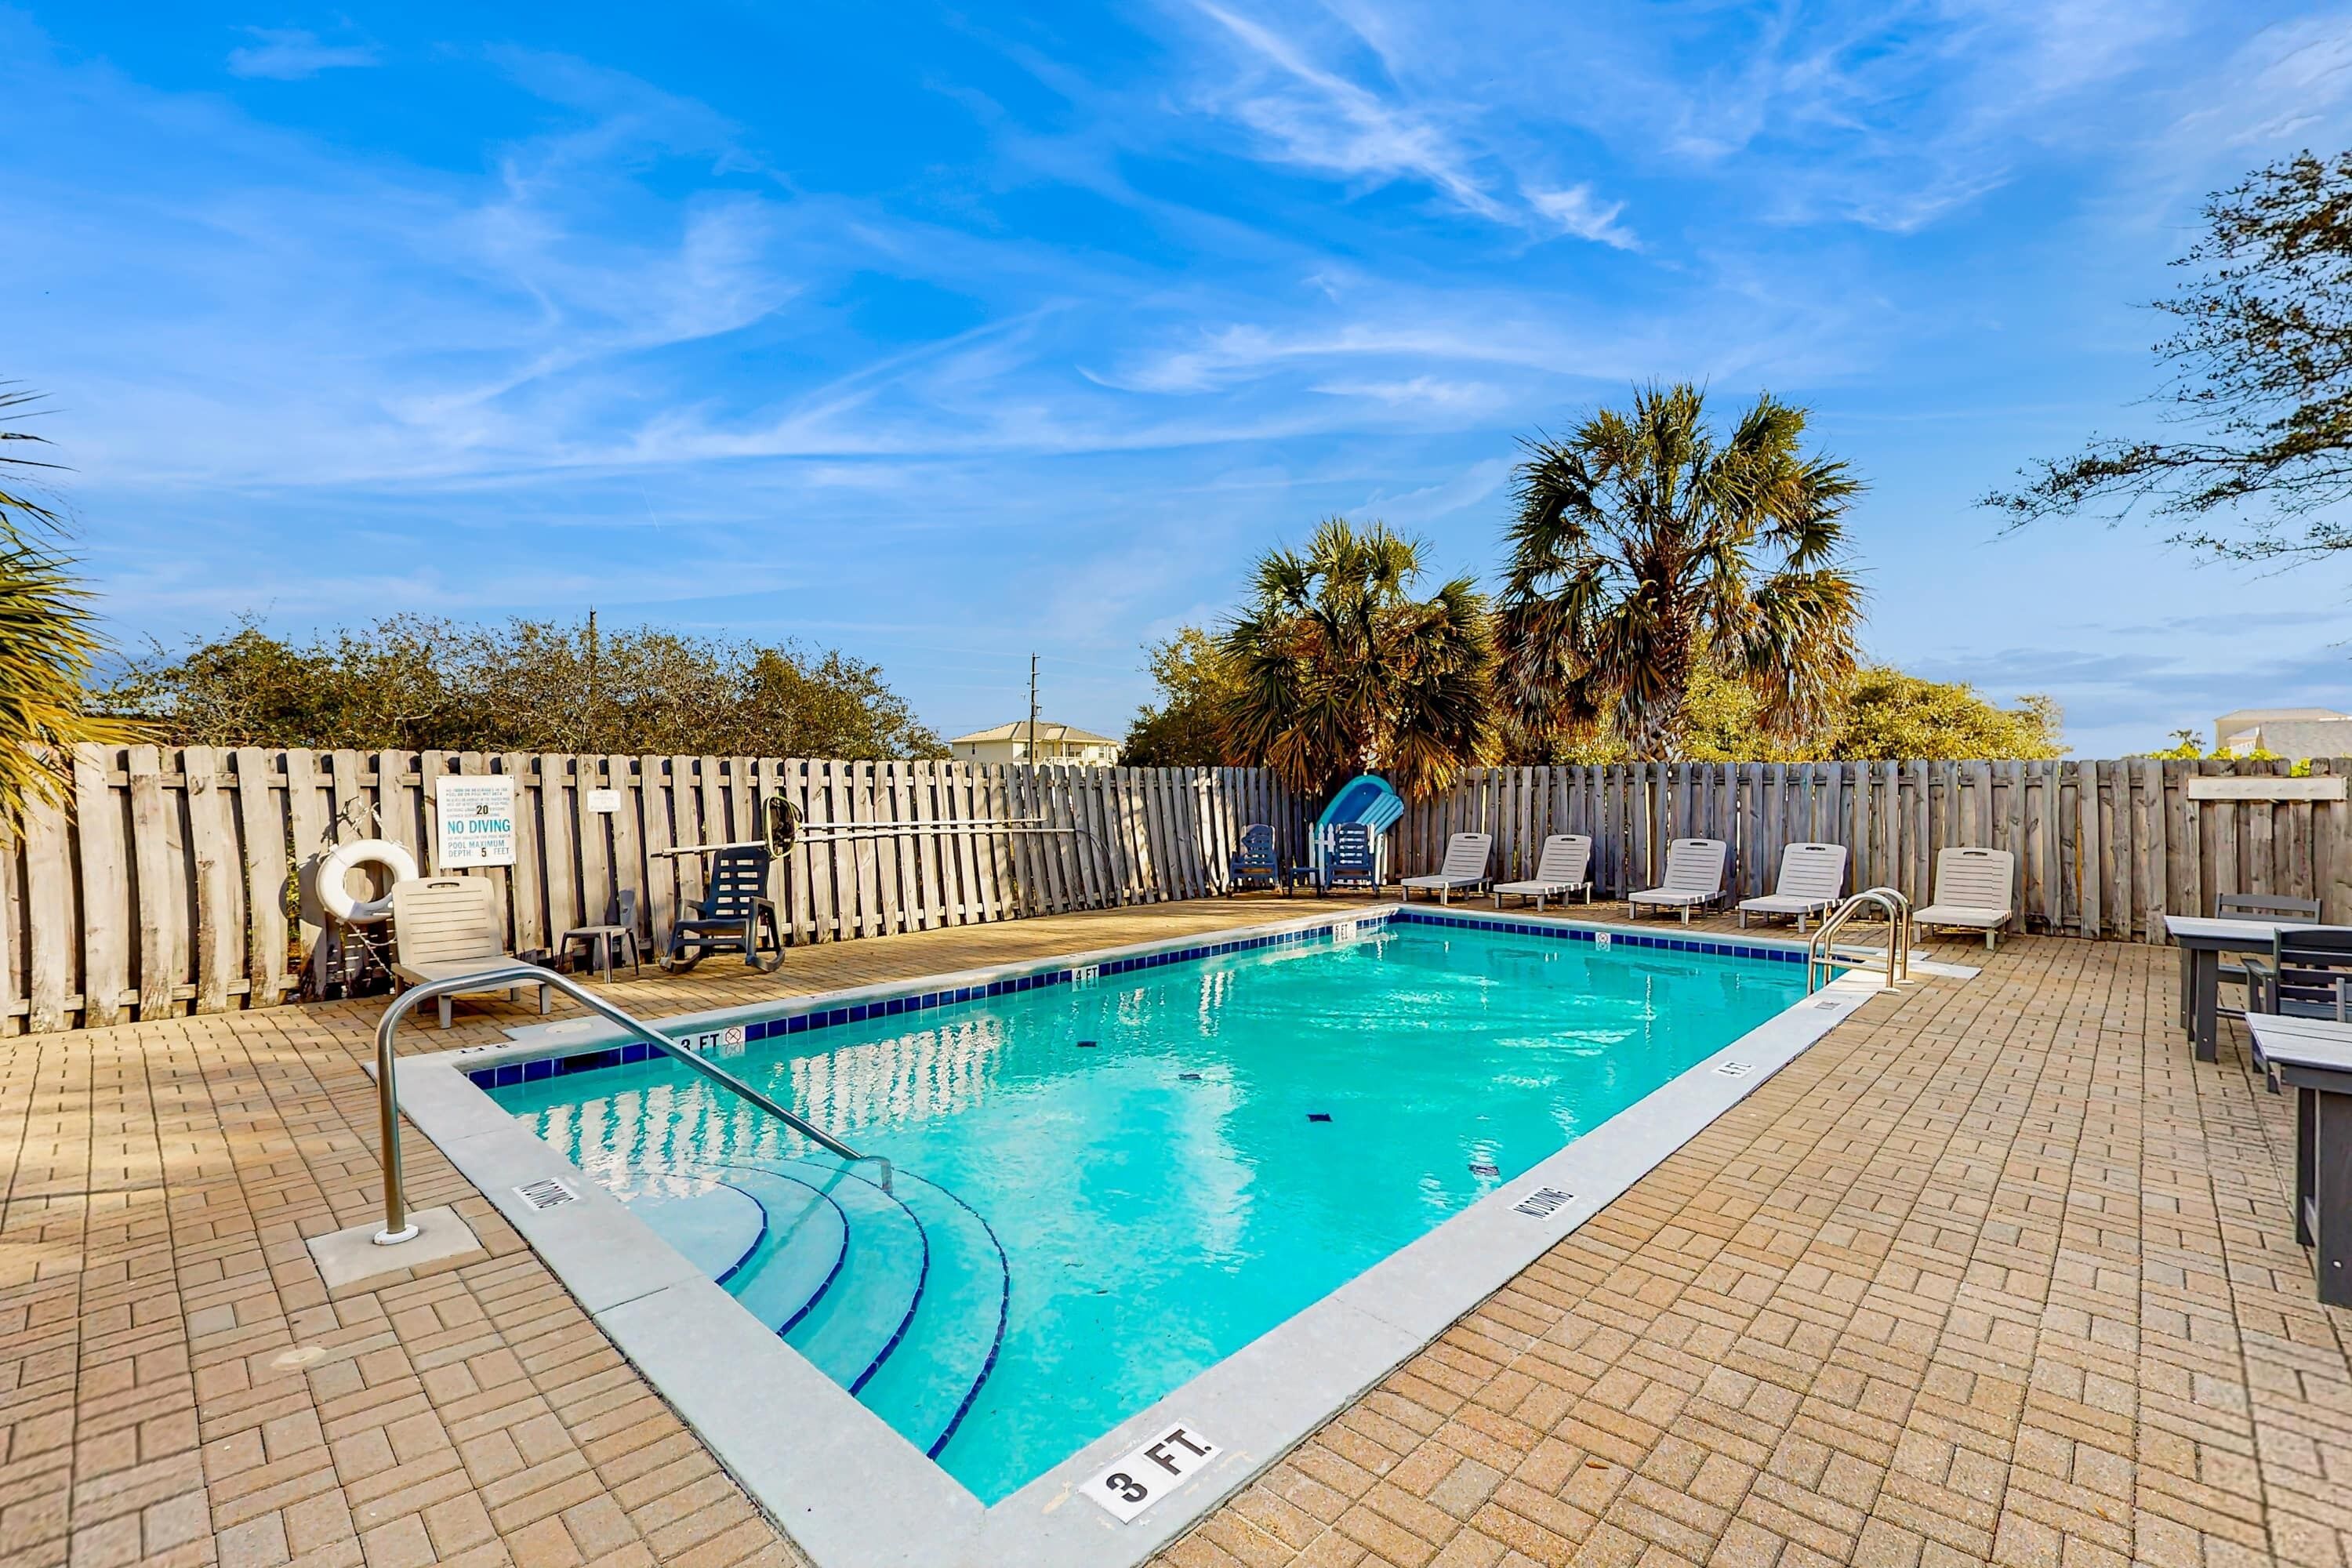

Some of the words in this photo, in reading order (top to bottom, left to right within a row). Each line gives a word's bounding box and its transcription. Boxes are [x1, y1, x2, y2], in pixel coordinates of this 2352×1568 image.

[477, 804, 488, 815] 20
[448, 820, 464, 834] NO
[470, 818, 510, 833] DIVING
[481, 848, 487, 857] 5
[1076, 970, 1082, 980] 4
[1086, 967, 1098, 979] FT
[699, 1033, 720, 1050] FT
[520, 1178, 557, 1192] NO
[524, 1185, 574, 1209] DIVING
[1523, 1187, 1574, 1211] DIVING
[1512, 1203, 1550, 1219] NO
[1105, 1472, 1149, 1503] 3
